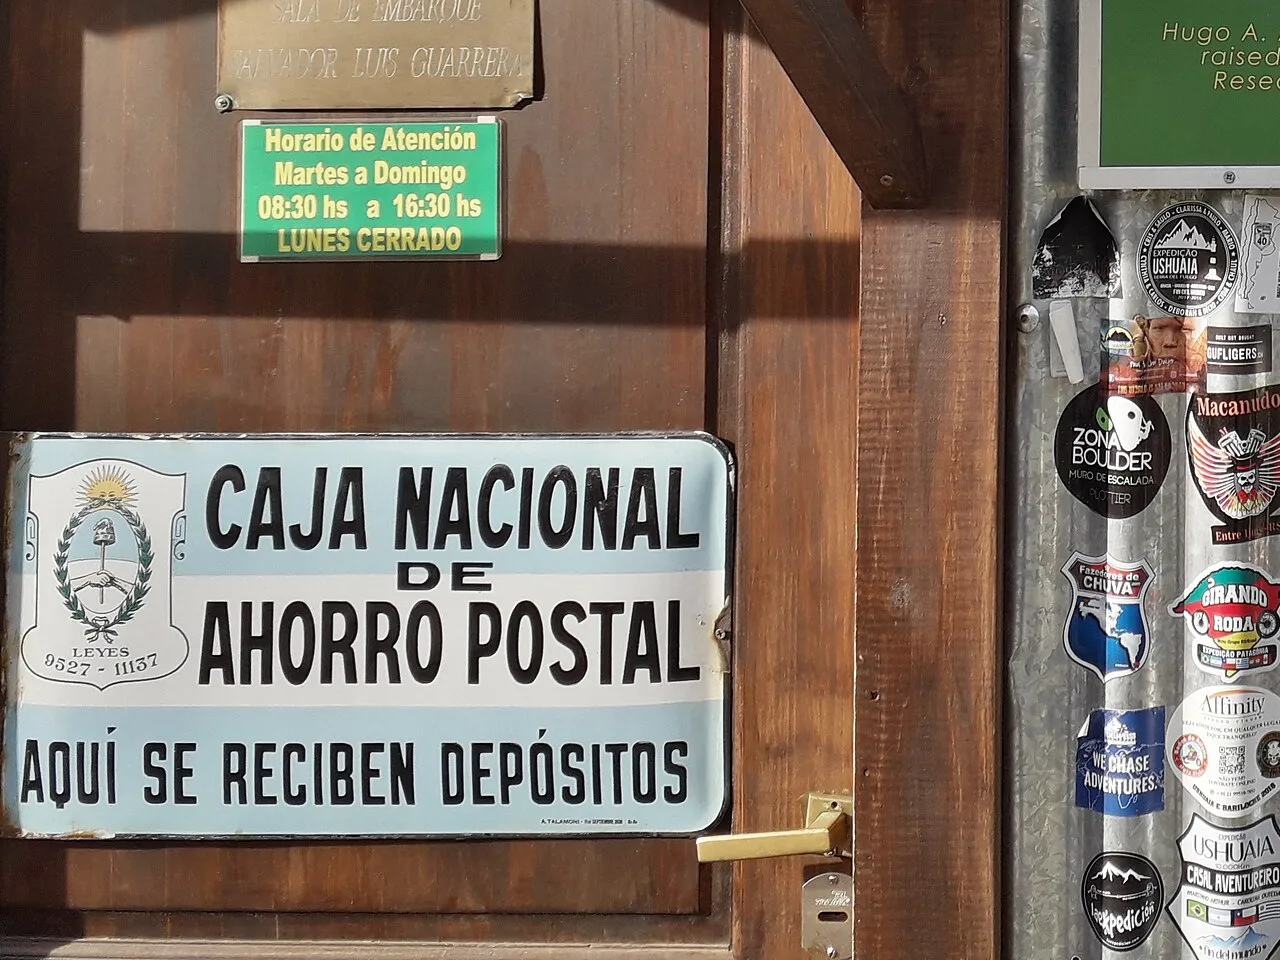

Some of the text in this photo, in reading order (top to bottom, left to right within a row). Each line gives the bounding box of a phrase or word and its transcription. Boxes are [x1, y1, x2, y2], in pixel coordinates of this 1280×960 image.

[1162, 22, 1231, 46] Hugo
[1241, 23, 1266, 43] A.
[1200, 47, 1280, 66] raised
[264, 125, 477, 153] Horario de Atención
[274, 161, 467, 190] Martes a Domingo
[257, 194, 482, 220] 08:30 hs a 16:30 hs
[277, 226, 462, 253] LUNES CERRADO
[1153, 248, 1198, 258] EXPEDIÇÃO
[1152, 258, 1198, 276] USHUAIA
[1072, 446, 1153, 472] BOULDER
[204, 463, 701, 551] CAJA NACIONAL
[396, 561, 494, 592] DE
[72, 647, 130, 658] LEYES
[198, 600, 702, 686] AHORRO POSTAL
[44, 653, 91, 677] 9527
[21, 727, 689, 809] AQUÍ SE RECIBEN DEPÓSITOS
[1092, 751, 1150, 775] WE CHASE
[1084, 770, 1158, 795] ADVENTURES.
[1187, 866, 1280, 893] CASAL AVENTUREIRO
